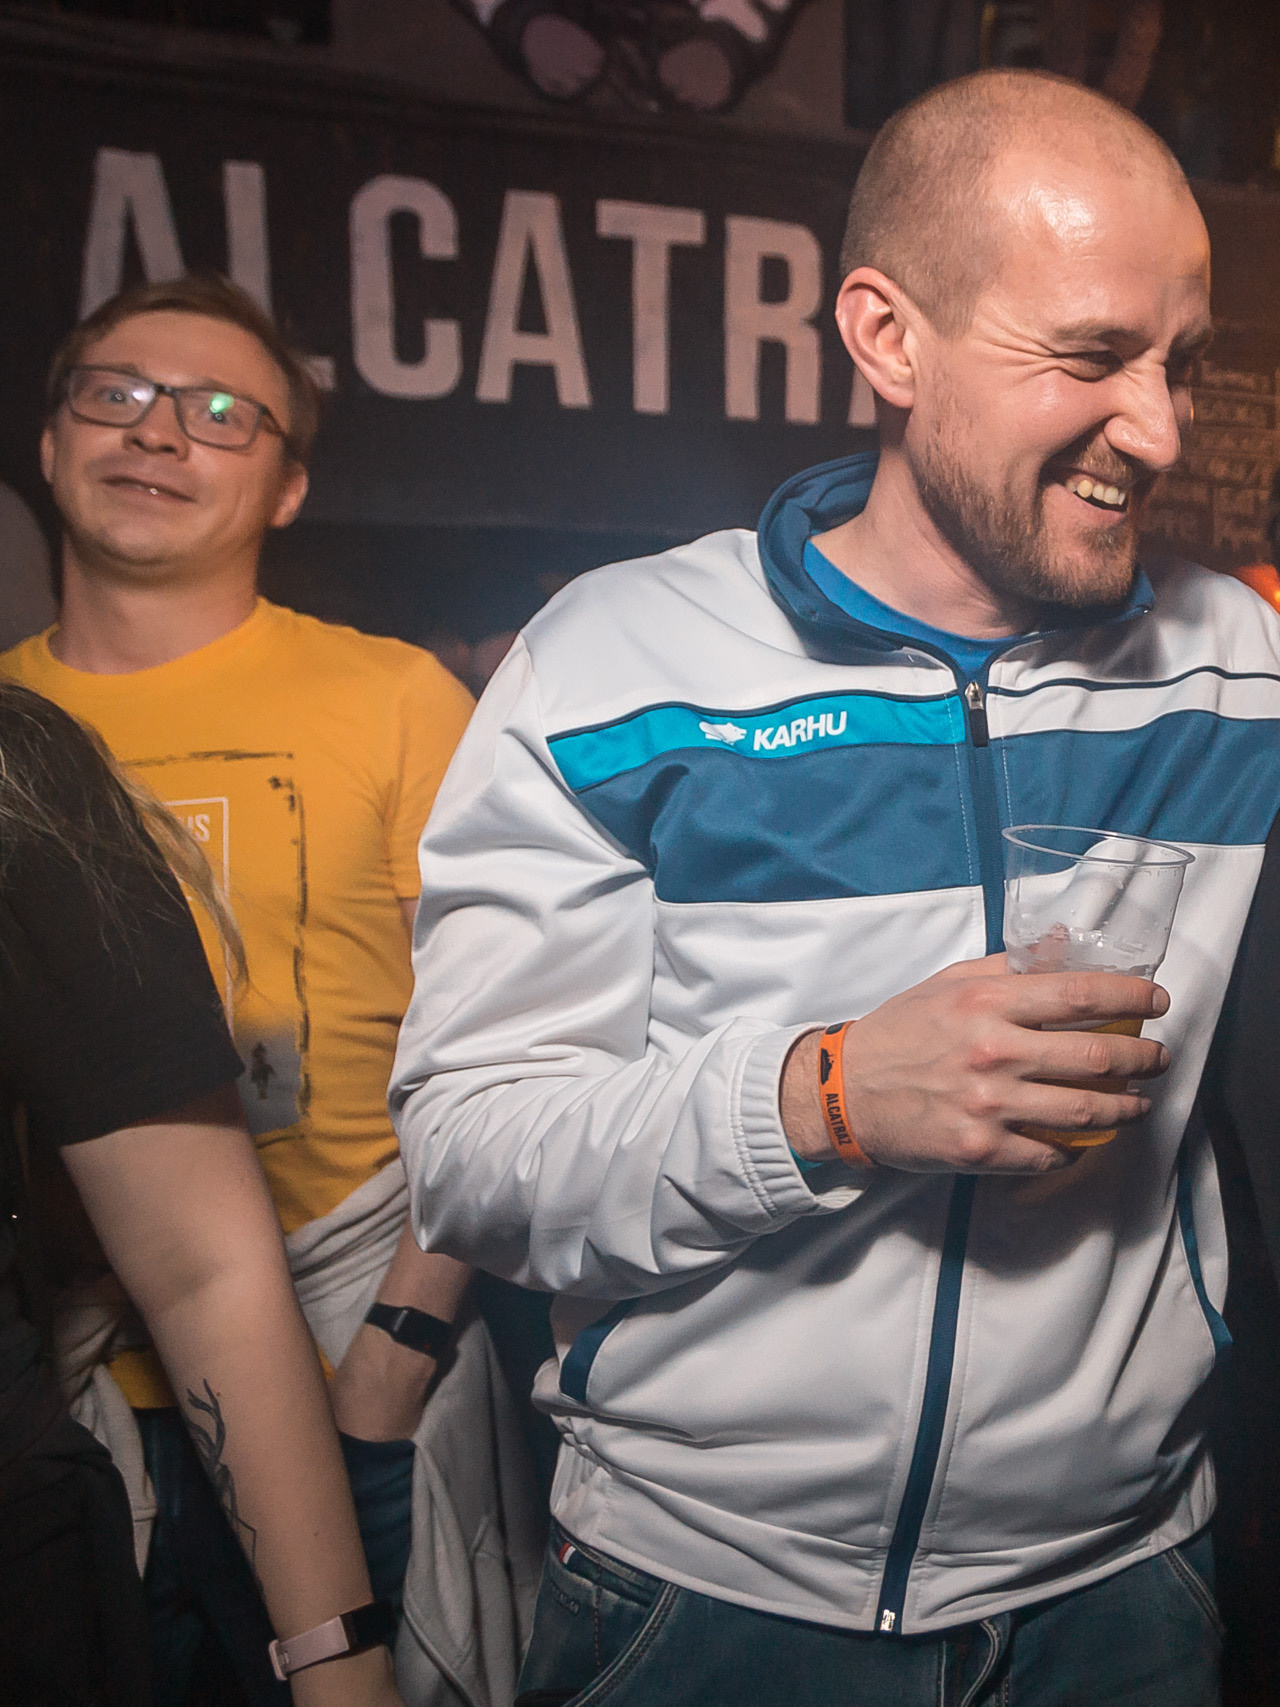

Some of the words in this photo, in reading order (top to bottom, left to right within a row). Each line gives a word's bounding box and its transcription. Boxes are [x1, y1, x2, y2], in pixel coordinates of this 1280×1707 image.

[79, 146, 877, 428] ALCATR
[753, 710, 848, 751] KARHU
[825, 1092, 853, 1146] ALCATRAZ
